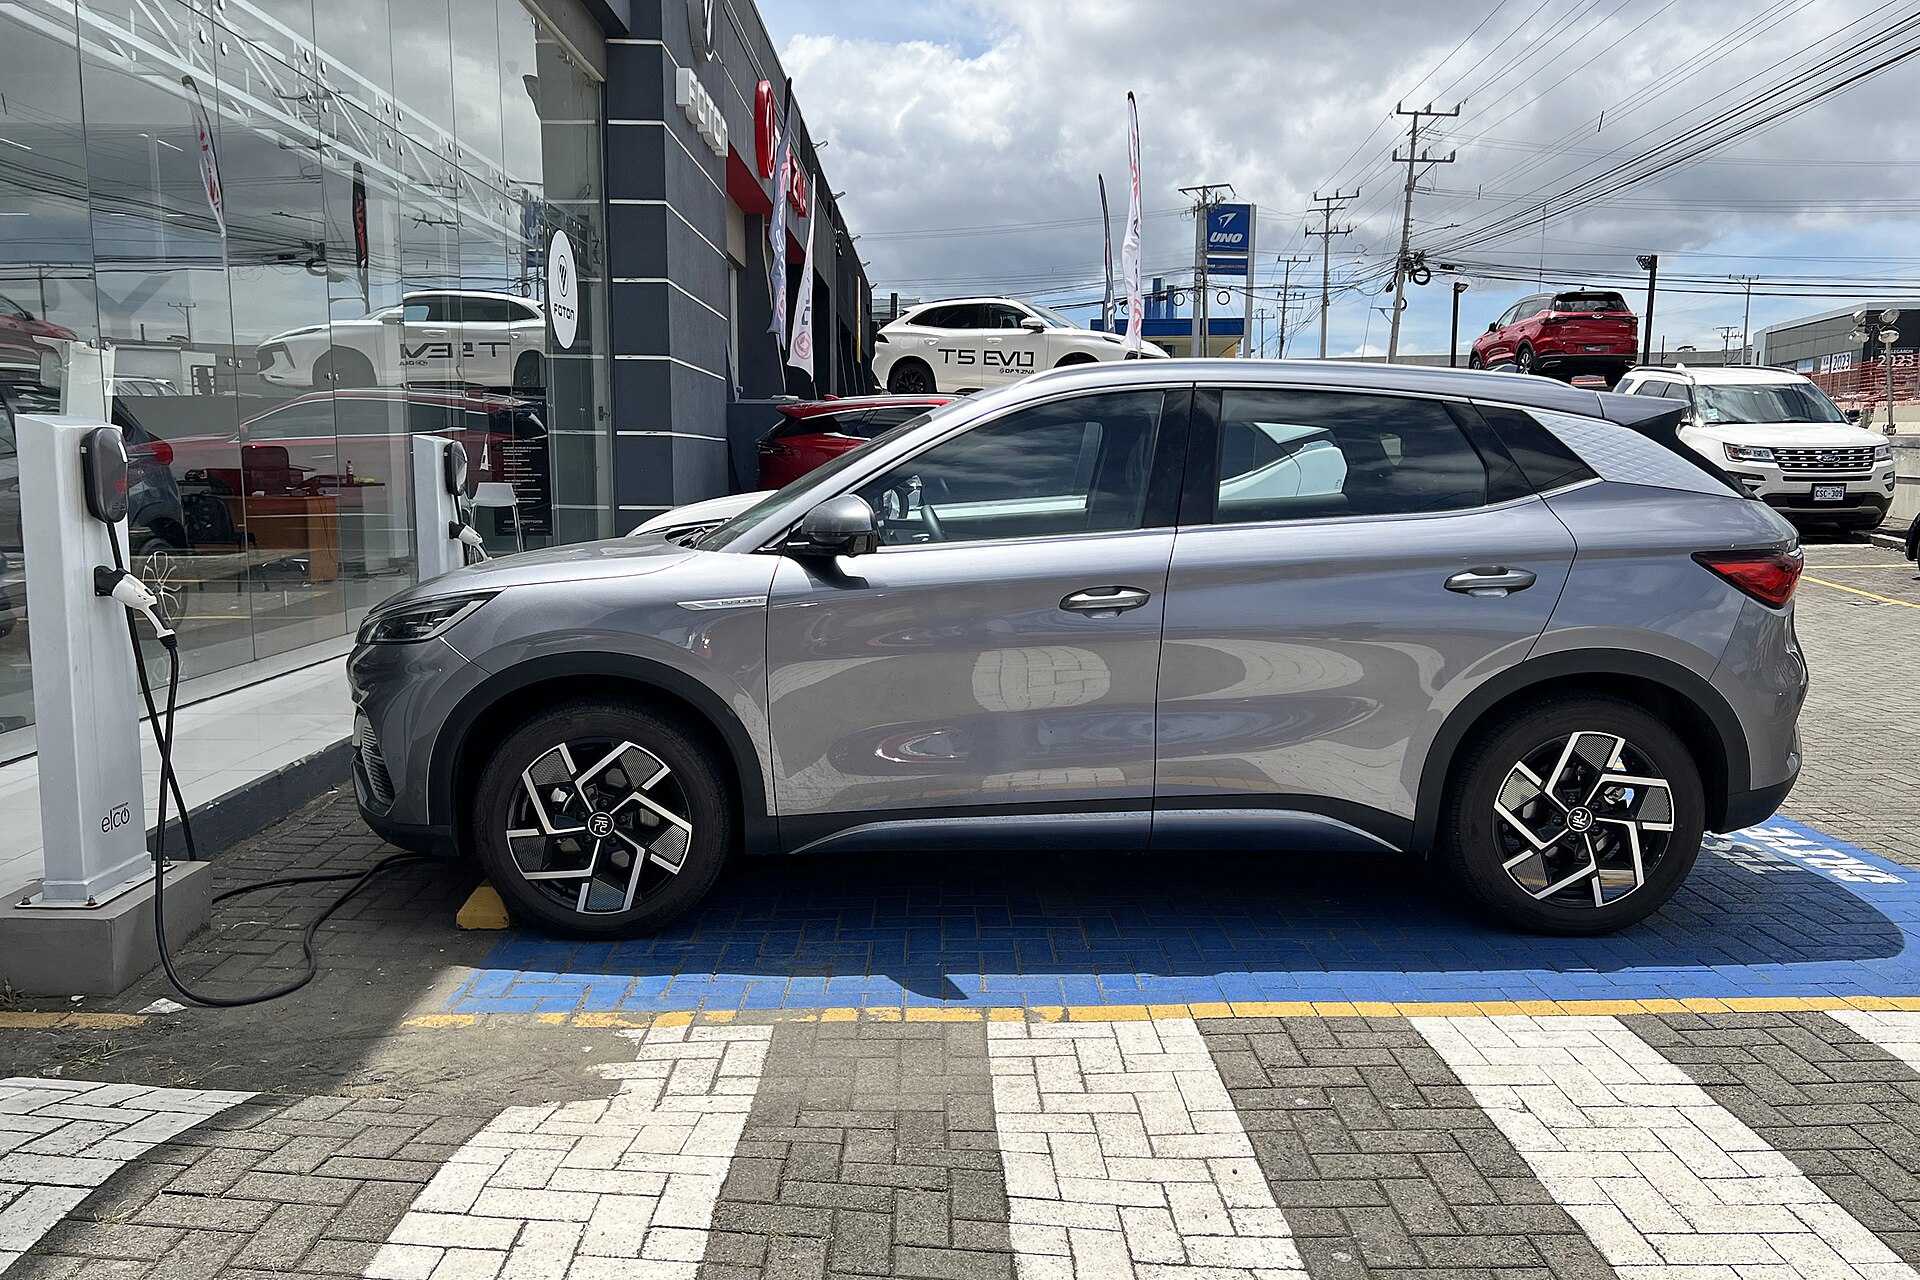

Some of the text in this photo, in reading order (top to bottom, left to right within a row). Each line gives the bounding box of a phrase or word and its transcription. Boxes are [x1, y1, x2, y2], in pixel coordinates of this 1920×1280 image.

[1209, 232, 1243, 243] UNO
[554, 303, 575, 321] FOTON
[938, 349, 1035, 367] T5 EVO
[1833, 354, 1850, 371] 2023
[1815, 489, 1843, 498] CSC-309
